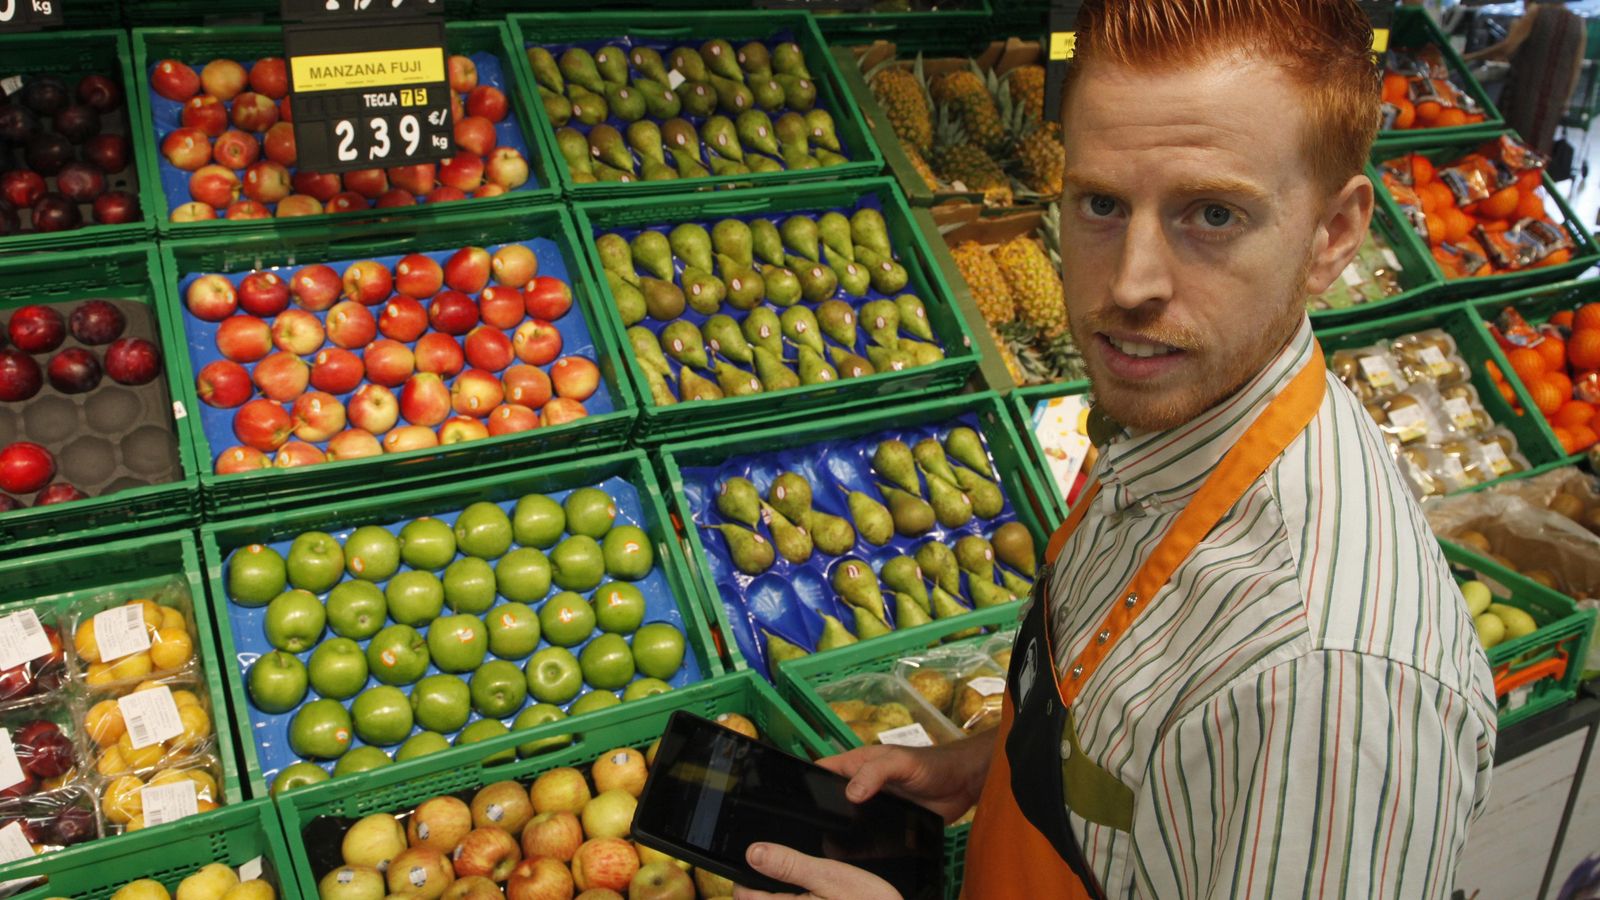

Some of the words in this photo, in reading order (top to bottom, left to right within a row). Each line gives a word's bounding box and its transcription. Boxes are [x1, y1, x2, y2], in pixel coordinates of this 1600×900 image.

[32, 0, 52, 15] kg
[309, 63, 386, 80] MANZANA
[391, 60, 422, 74] FUJI
[363, 92, 398, 108] TECLA
[401, 89, 426, 105] 75
[431, 134, 448, 150] kg
